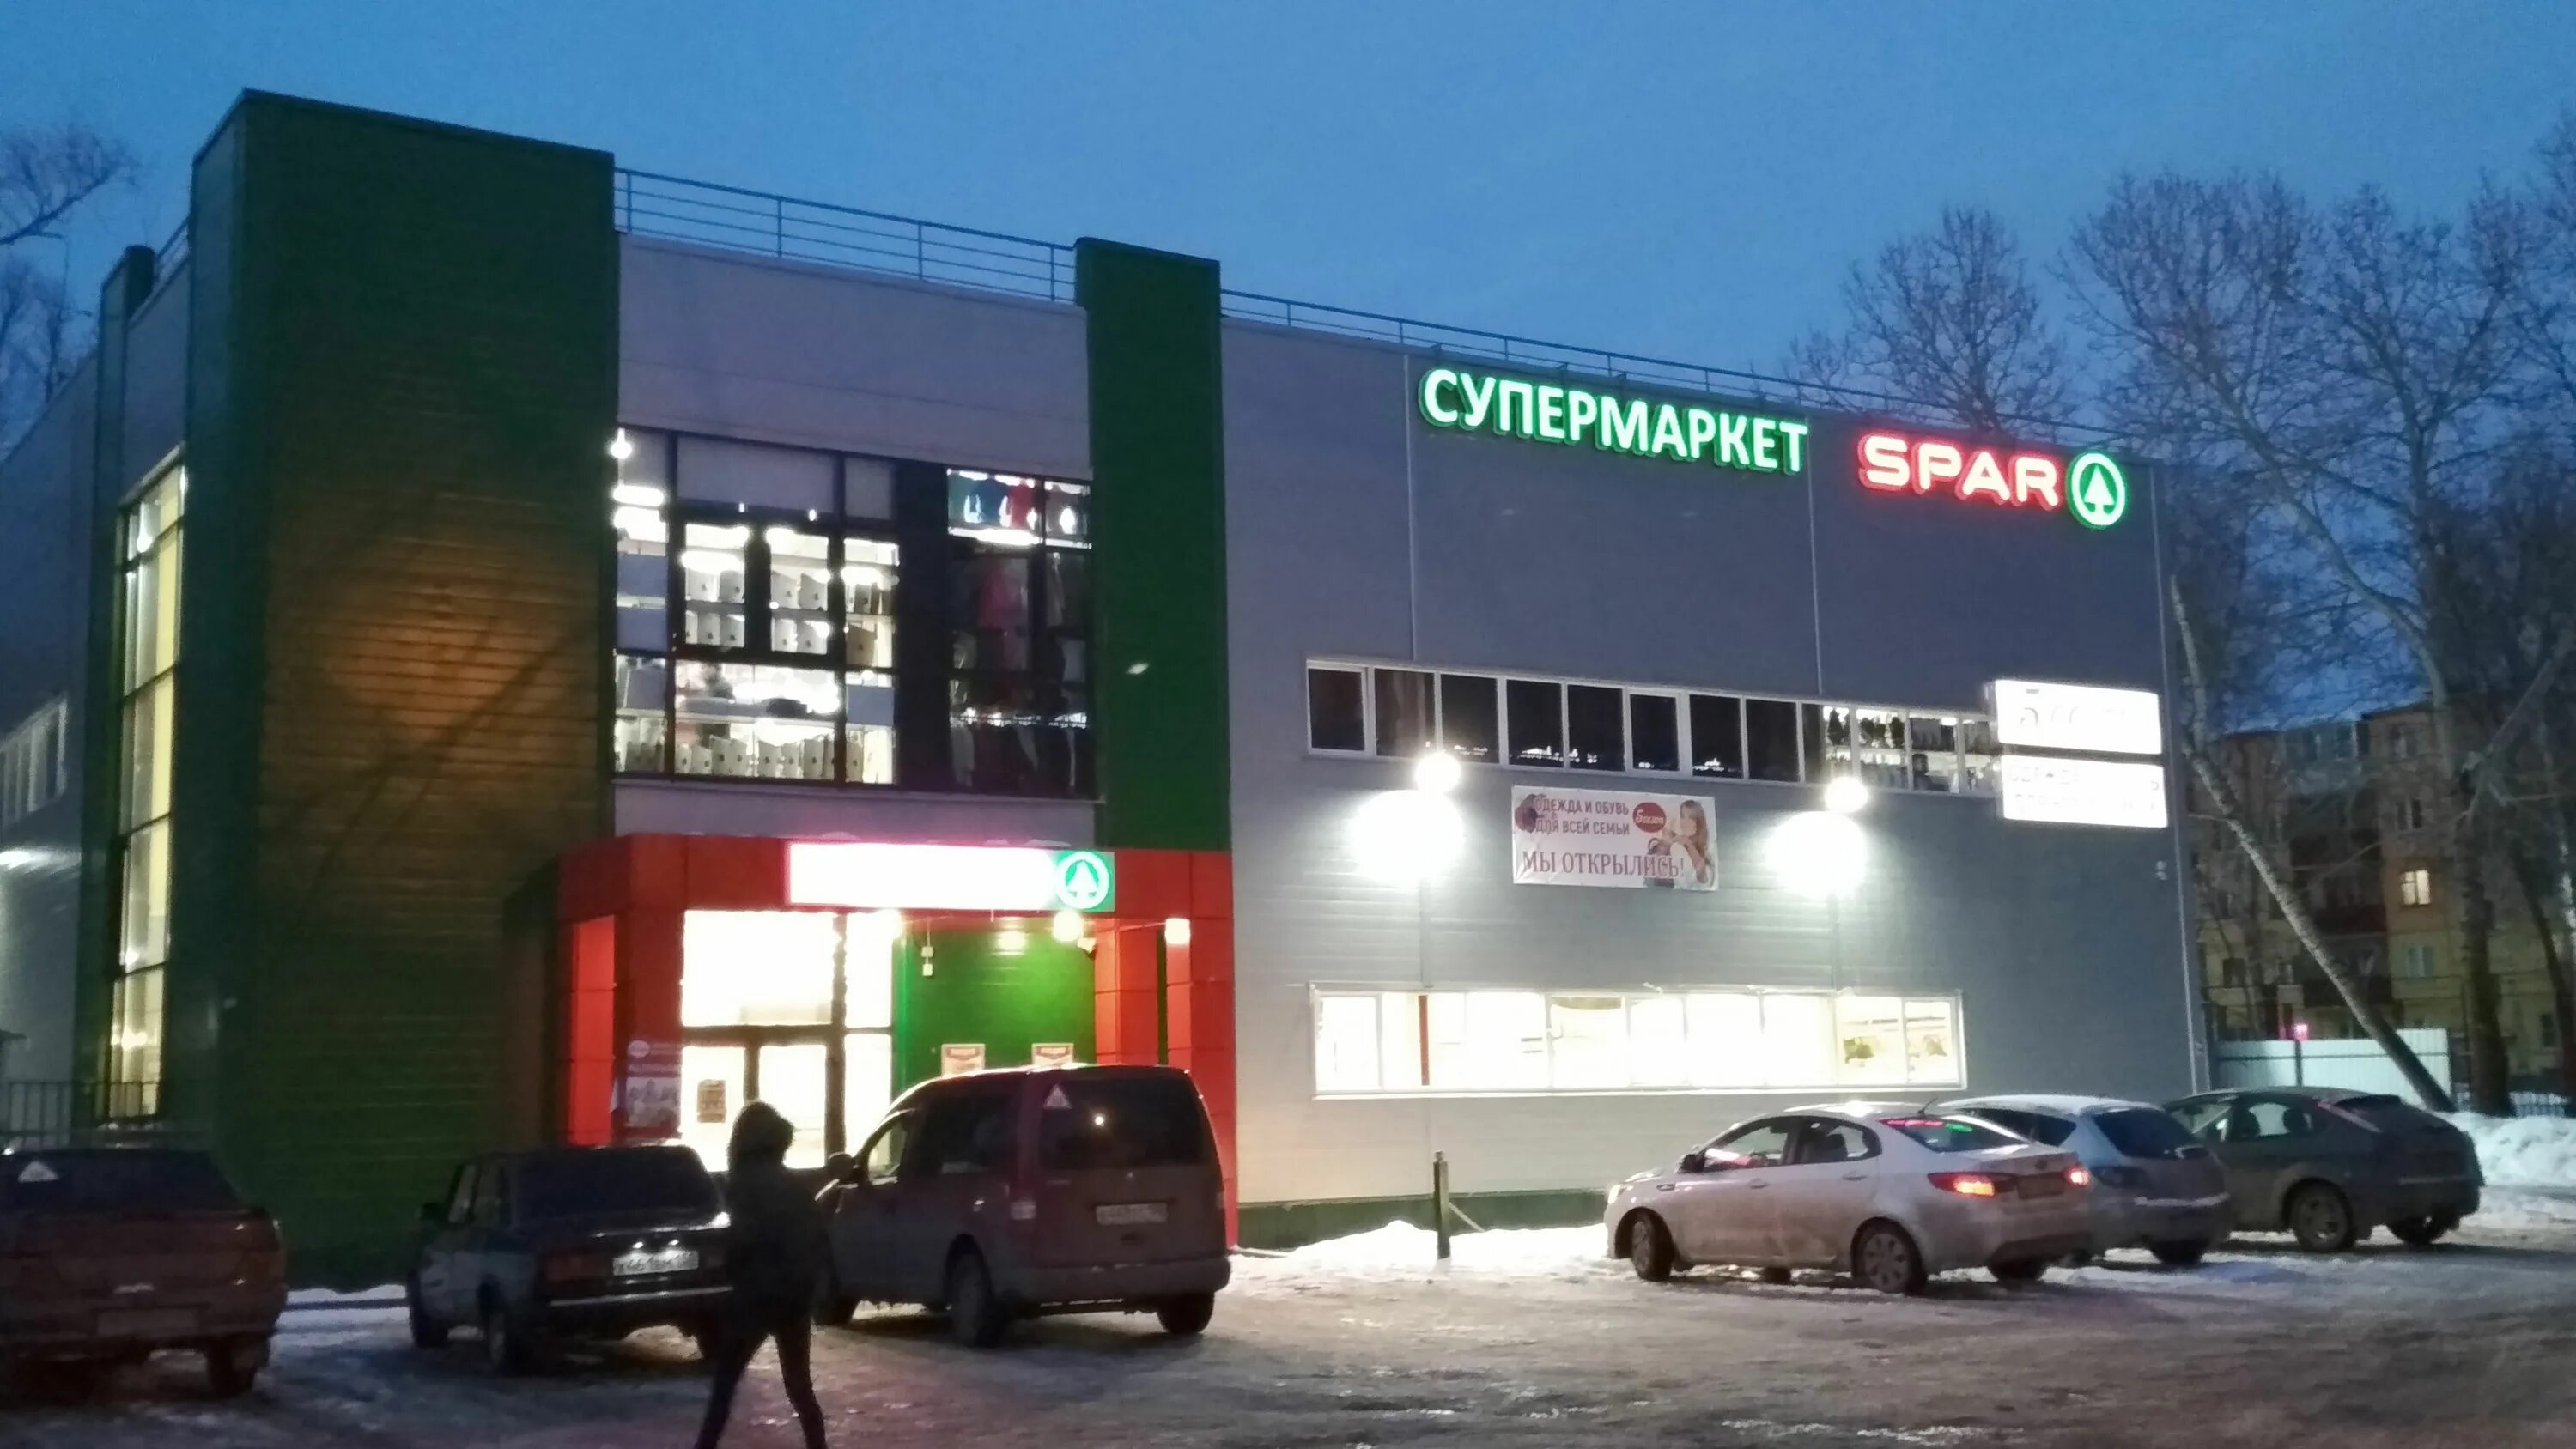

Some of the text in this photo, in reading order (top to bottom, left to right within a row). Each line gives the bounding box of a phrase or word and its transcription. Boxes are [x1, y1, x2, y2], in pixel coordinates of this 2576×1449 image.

[1419, 368, 1808, 475] СУПЕРМАРКЕТ
[1857, 434, 2059, 510] SPAR
[1534, 798, 1629, 815] ОДЕЖДА И ОБУВЬ
[1563, 818, 1589, 834] ВСЕЙ
[1594, 822, 1630, 834] СЕМЬИ
[1522, 851, 1684, 878] МЫ ОТКРЫЛИСЬ!
